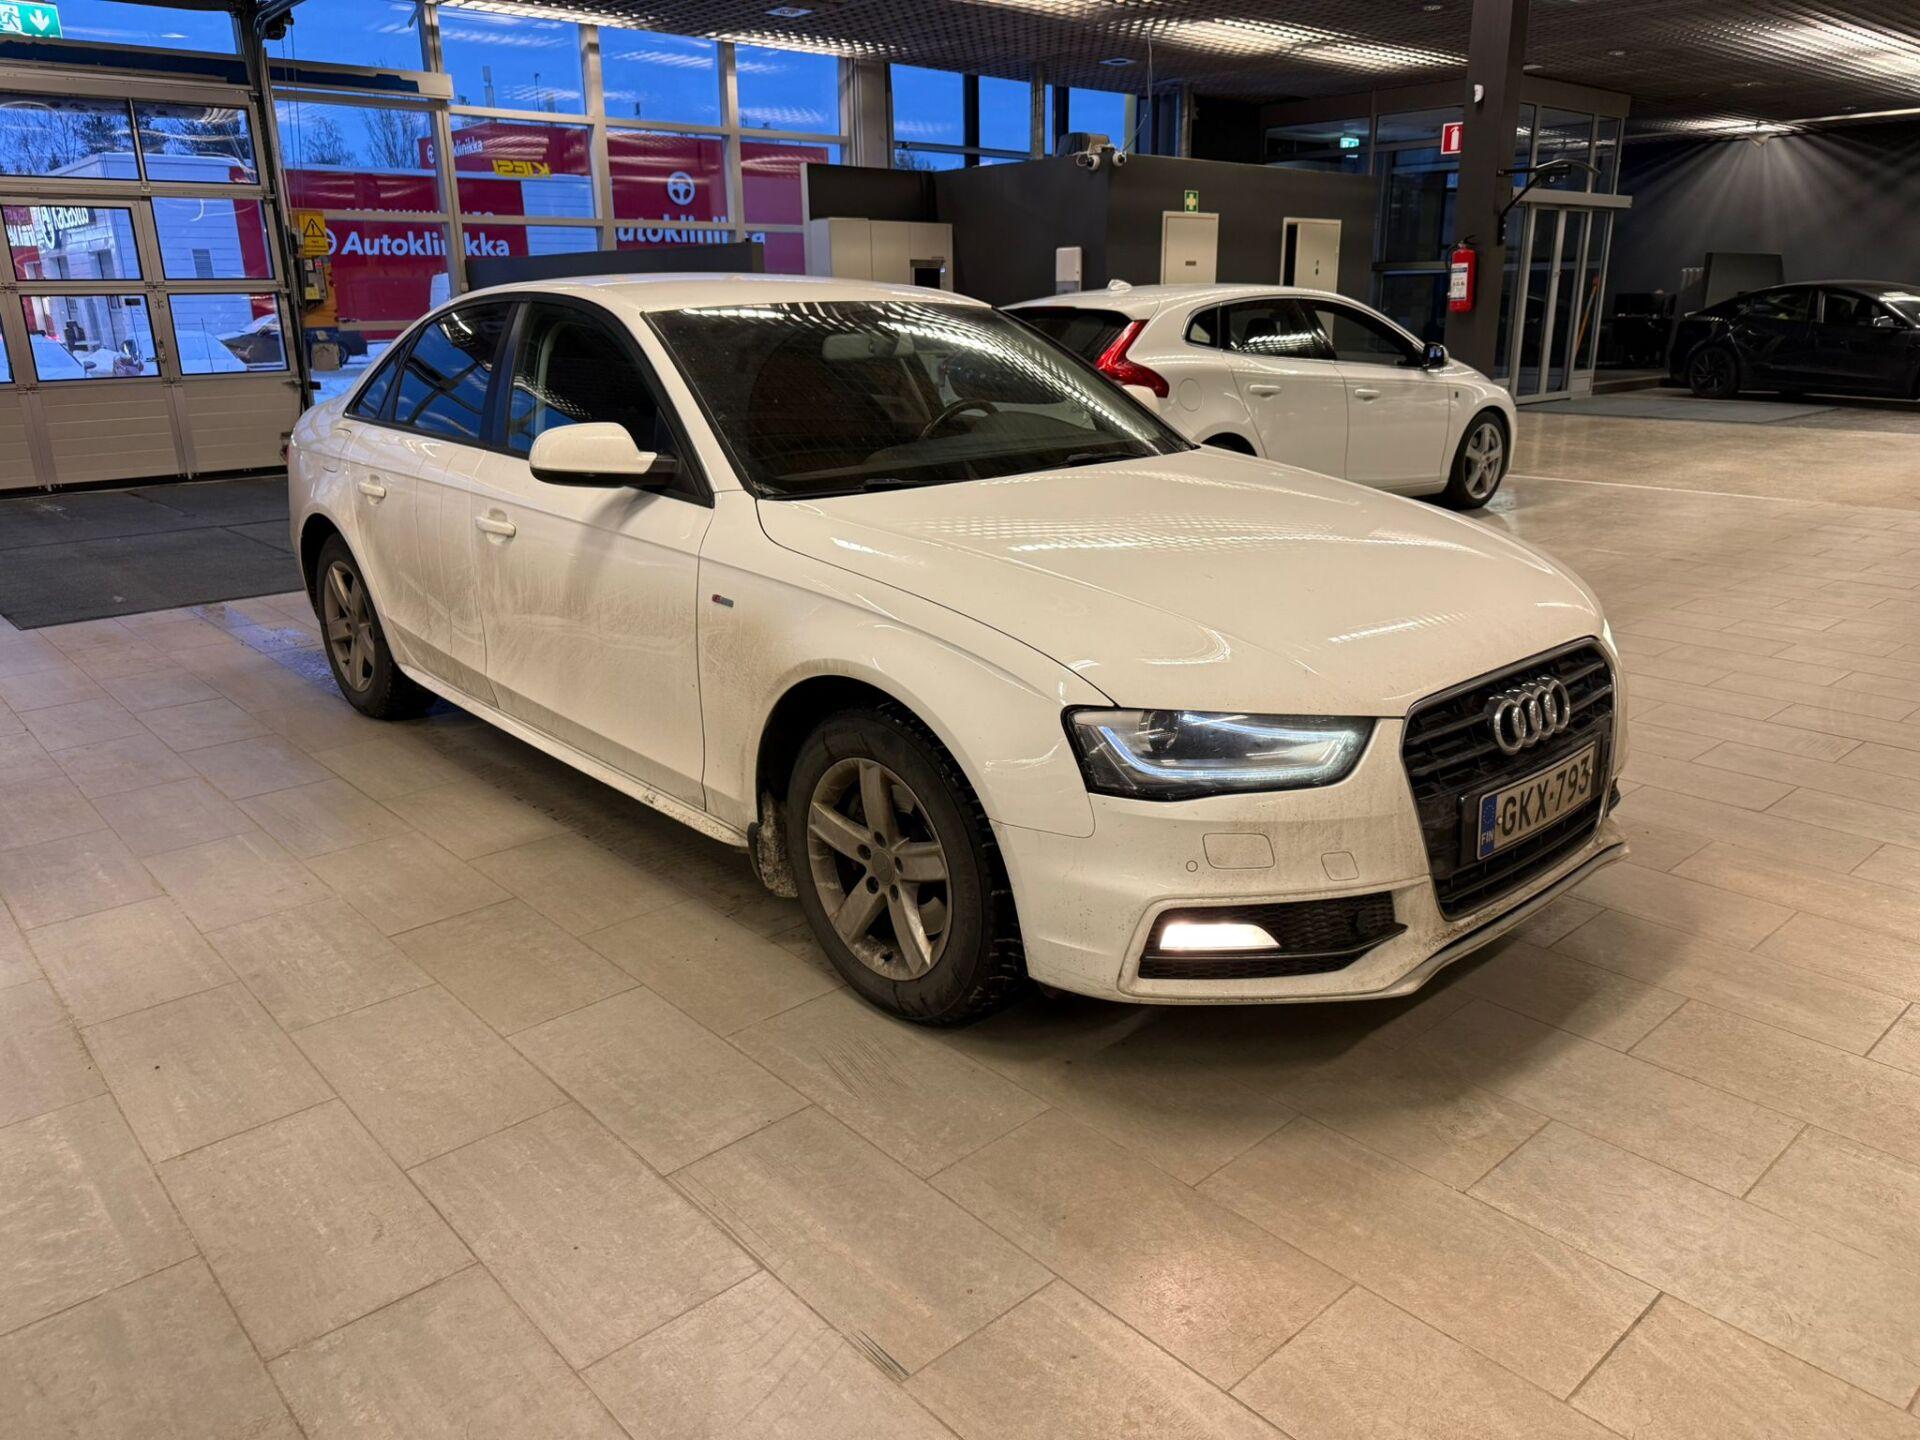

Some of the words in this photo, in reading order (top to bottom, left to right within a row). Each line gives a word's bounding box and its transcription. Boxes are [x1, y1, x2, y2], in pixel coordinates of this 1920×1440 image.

[340, 231, 511, 257] Autoklikka
[1502, 755, 1591, 836] GKX-793
[1481, 830, 1495, 846] FIN
